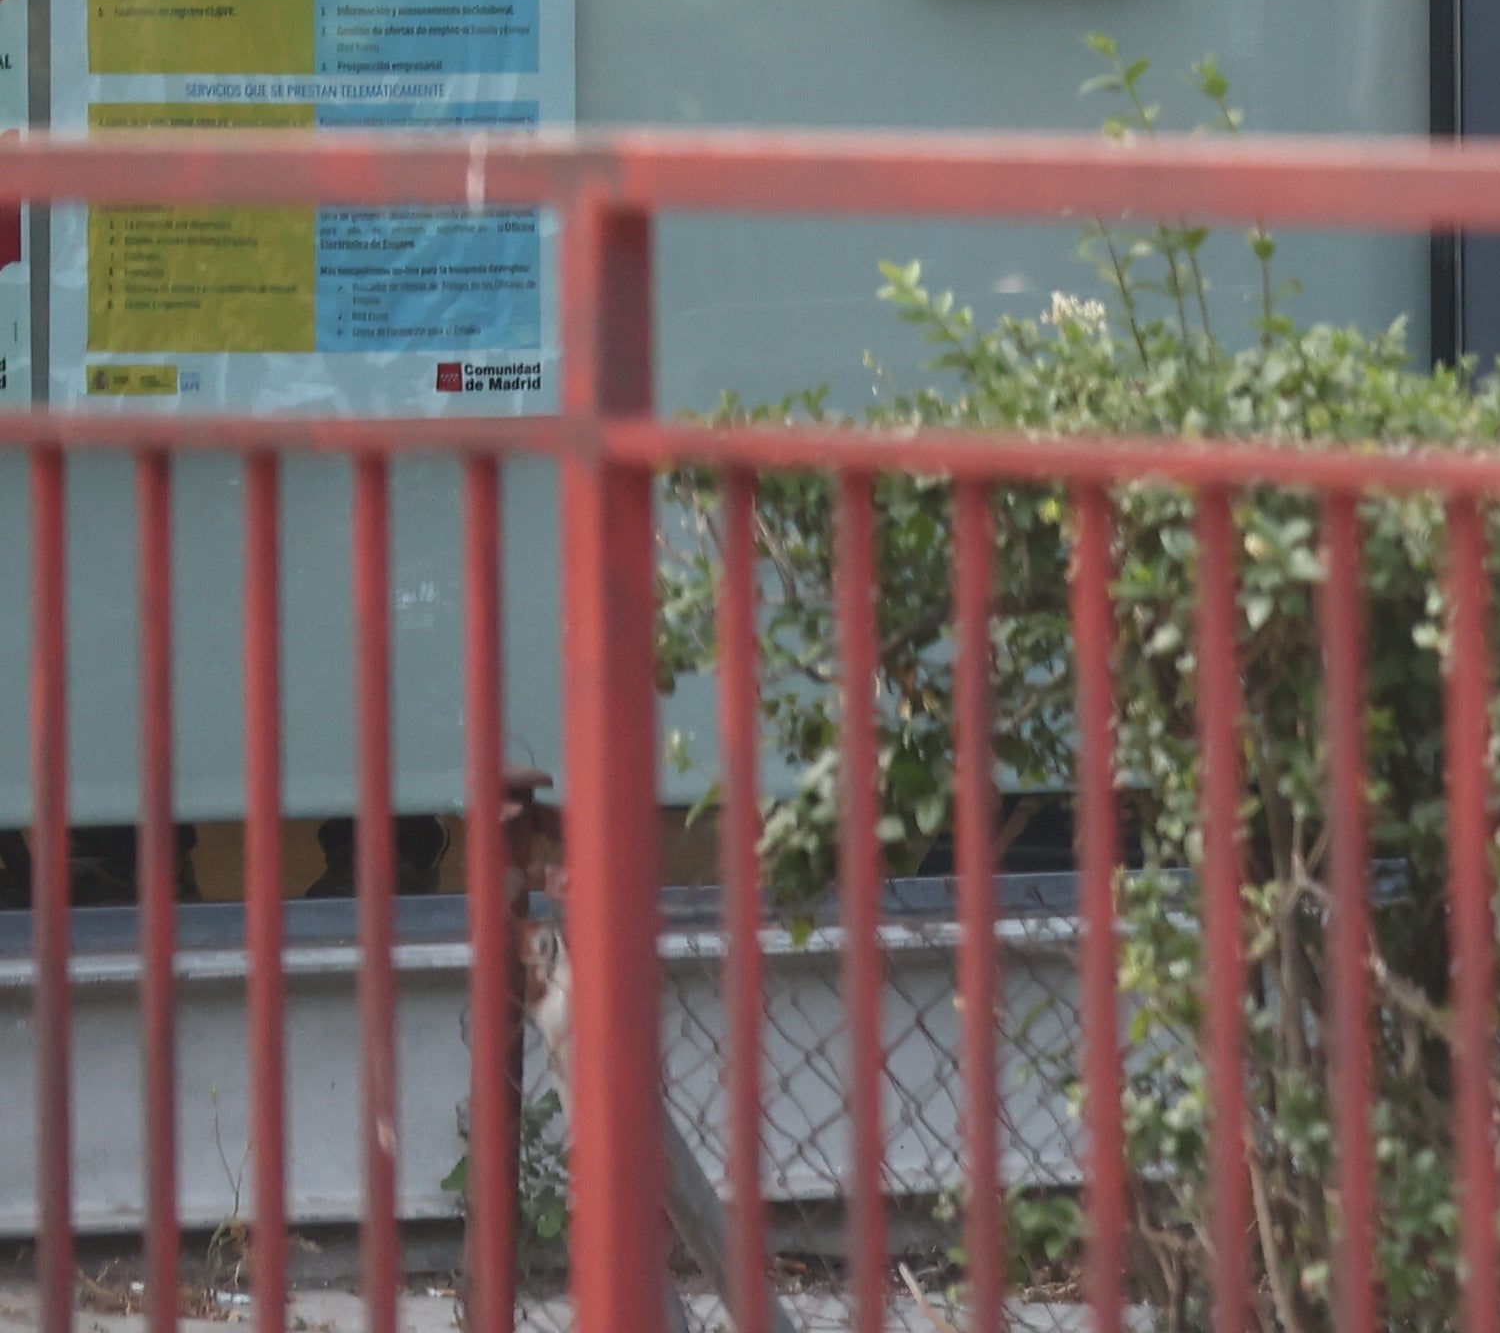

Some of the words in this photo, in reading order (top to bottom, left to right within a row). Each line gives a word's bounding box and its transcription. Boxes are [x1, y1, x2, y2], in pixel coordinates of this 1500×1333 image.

[187, 84, 241, 97] SERVICIOS
[245, 84, 265, 97] QUE
[271, 84, 284, 97] SE
[287, 83, 337, 97] PRESTAN
[341, 82, 445, 97] TELEMÁTICAMENTE
[465, 363, 540, 376] Comunidad
[466, 378, 483, 391] de
[489, 378, 540, 390] Madrid
